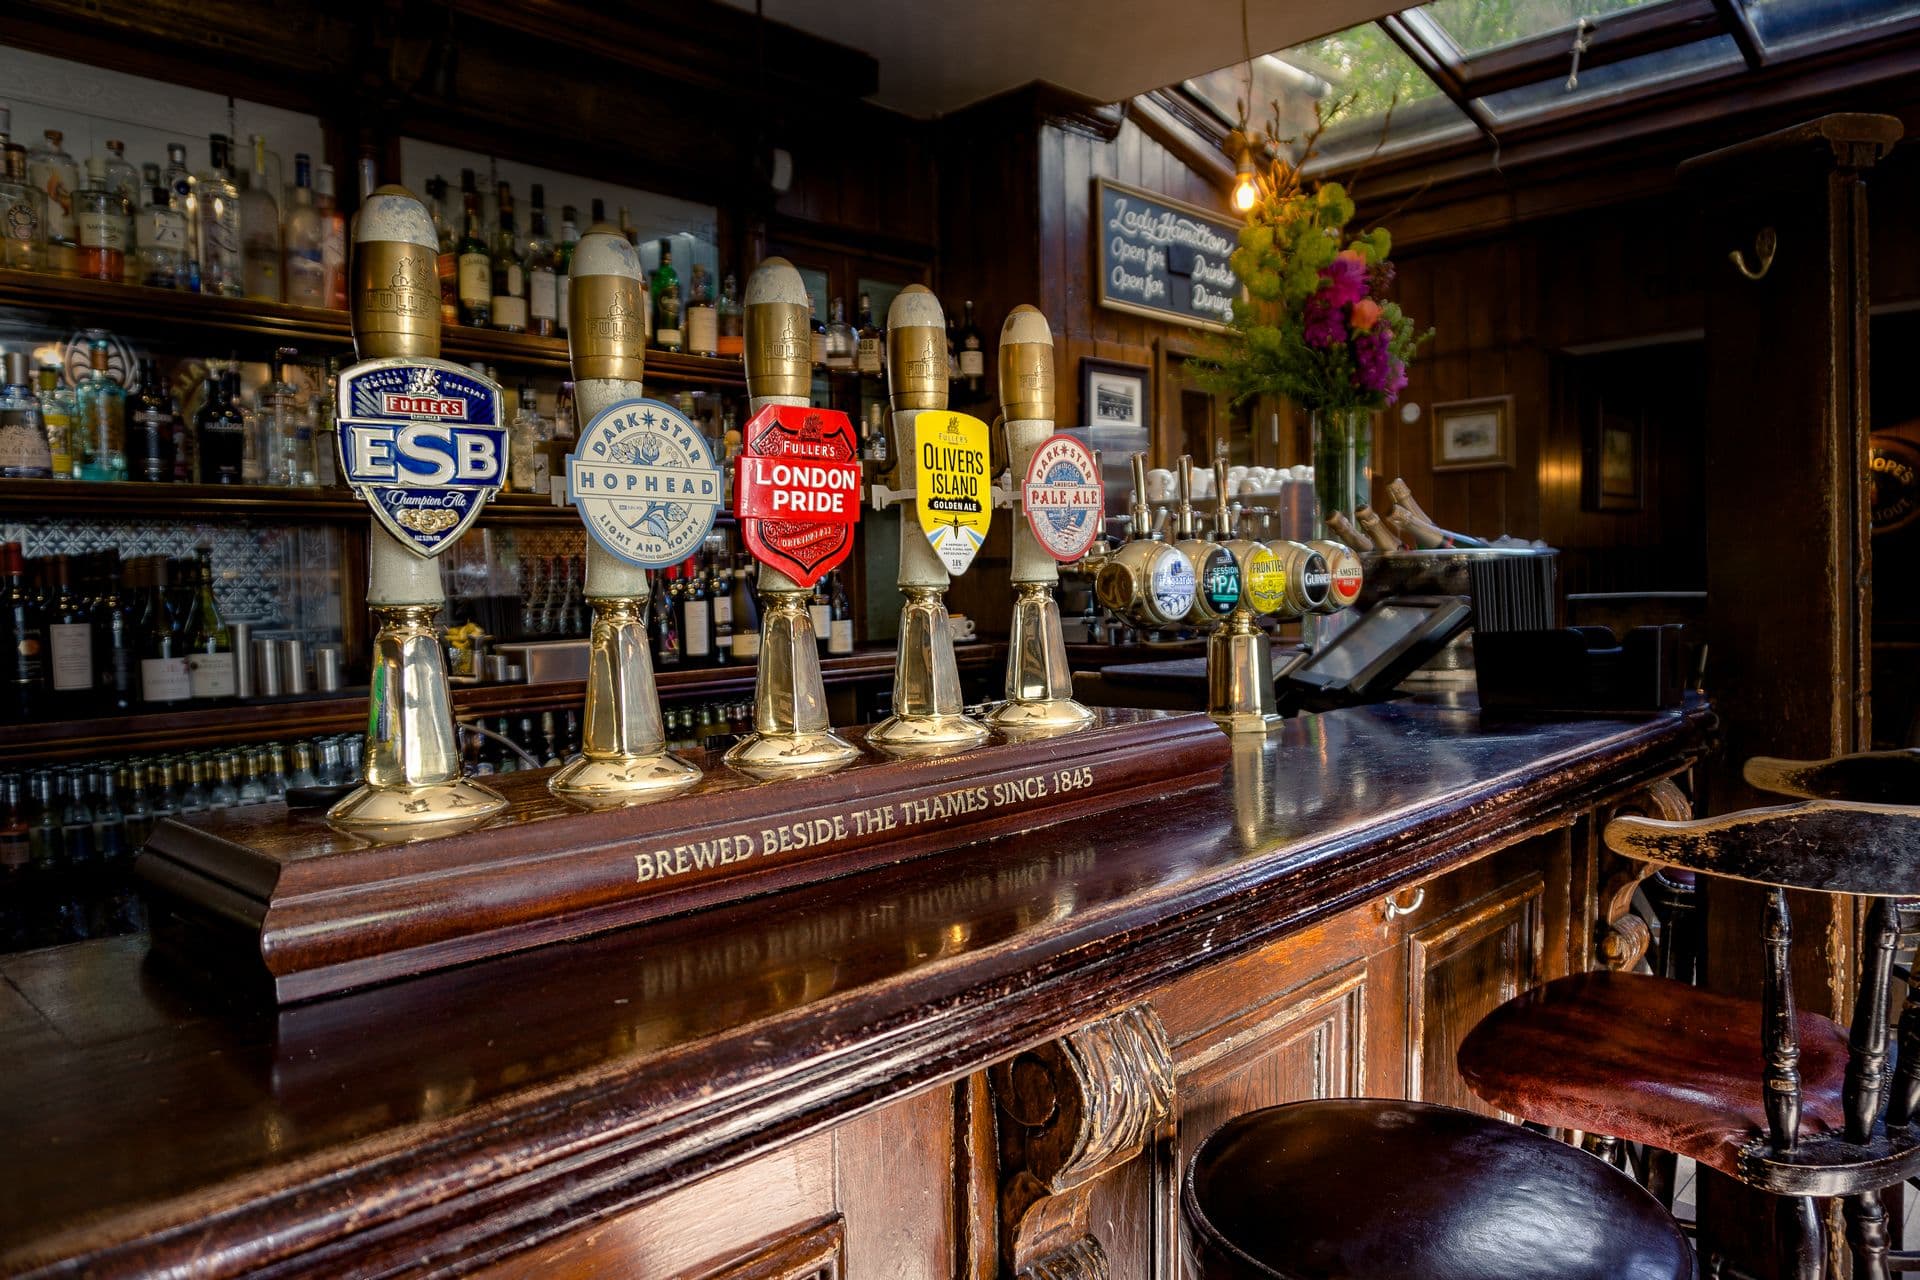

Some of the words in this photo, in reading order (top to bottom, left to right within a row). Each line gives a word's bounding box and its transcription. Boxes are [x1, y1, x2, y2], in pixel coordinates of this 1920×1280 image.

[1110, 198, 1163, 245] Lady
[1158, 212, 1234, 257] Hamilton
[1111, 236, 1145, 262] Open
[1145, 245, 1166, 272] for
[1191, 254, 1236, 288] Drinks
[1111, 265, 1144, 291] Open
[1143, 274, 1166, 299] for
[1191, 284, 1234, 322] Dining
[445, 381, 486, 400] SPECIAL
[389, 397, 460, 415] FULLER'S
[592, 412, 640, 456] DARK
[659, 417, 701, 463] STAR
[783, 440, 835, 457] FULLER'S
[351, 424, 498, 485] ESB
[923, 443, 984, 475] OLIVER'S
[1036, 445, 1060, 480] DARK
[1070, 448, 1092, 480] STAR
[580, 471, 714, 495] HOPHEAD
[756, 463, 855, 490] LONDON
[932, 473, 977, 496] ISLAND
[386, 490, 441, 510] Champion
[442, 491, 466, 507] Ale
[772, 490, 844, 513] PRIDE
[933, 500, 964, 511] GOLDEN
[964, 502, 977, 511] ALE
[1031, 490, 1067, 504] PALE
[1073, 490, 1097, 504] ALE
[600, 514, 632, 546] LIGHT
[636, 543, 662, 553] AND
[667, 517, 699, 549] HOPPY
[1212, 566, 1239, 575] SESSION
[1338, 567, 1361, 576] AMSTEL
[1212, 575, 1239, 593] IPA
[636, 834, 755, 883] BREWED
[761, 815, 849, 857] BESIDE
[851, 808, 897, 836] THE
[900, 787, 989, 826] THAMES
[993, 776, 1047, 807] SINCE
[1052, 766, 1095, 794] 1845
